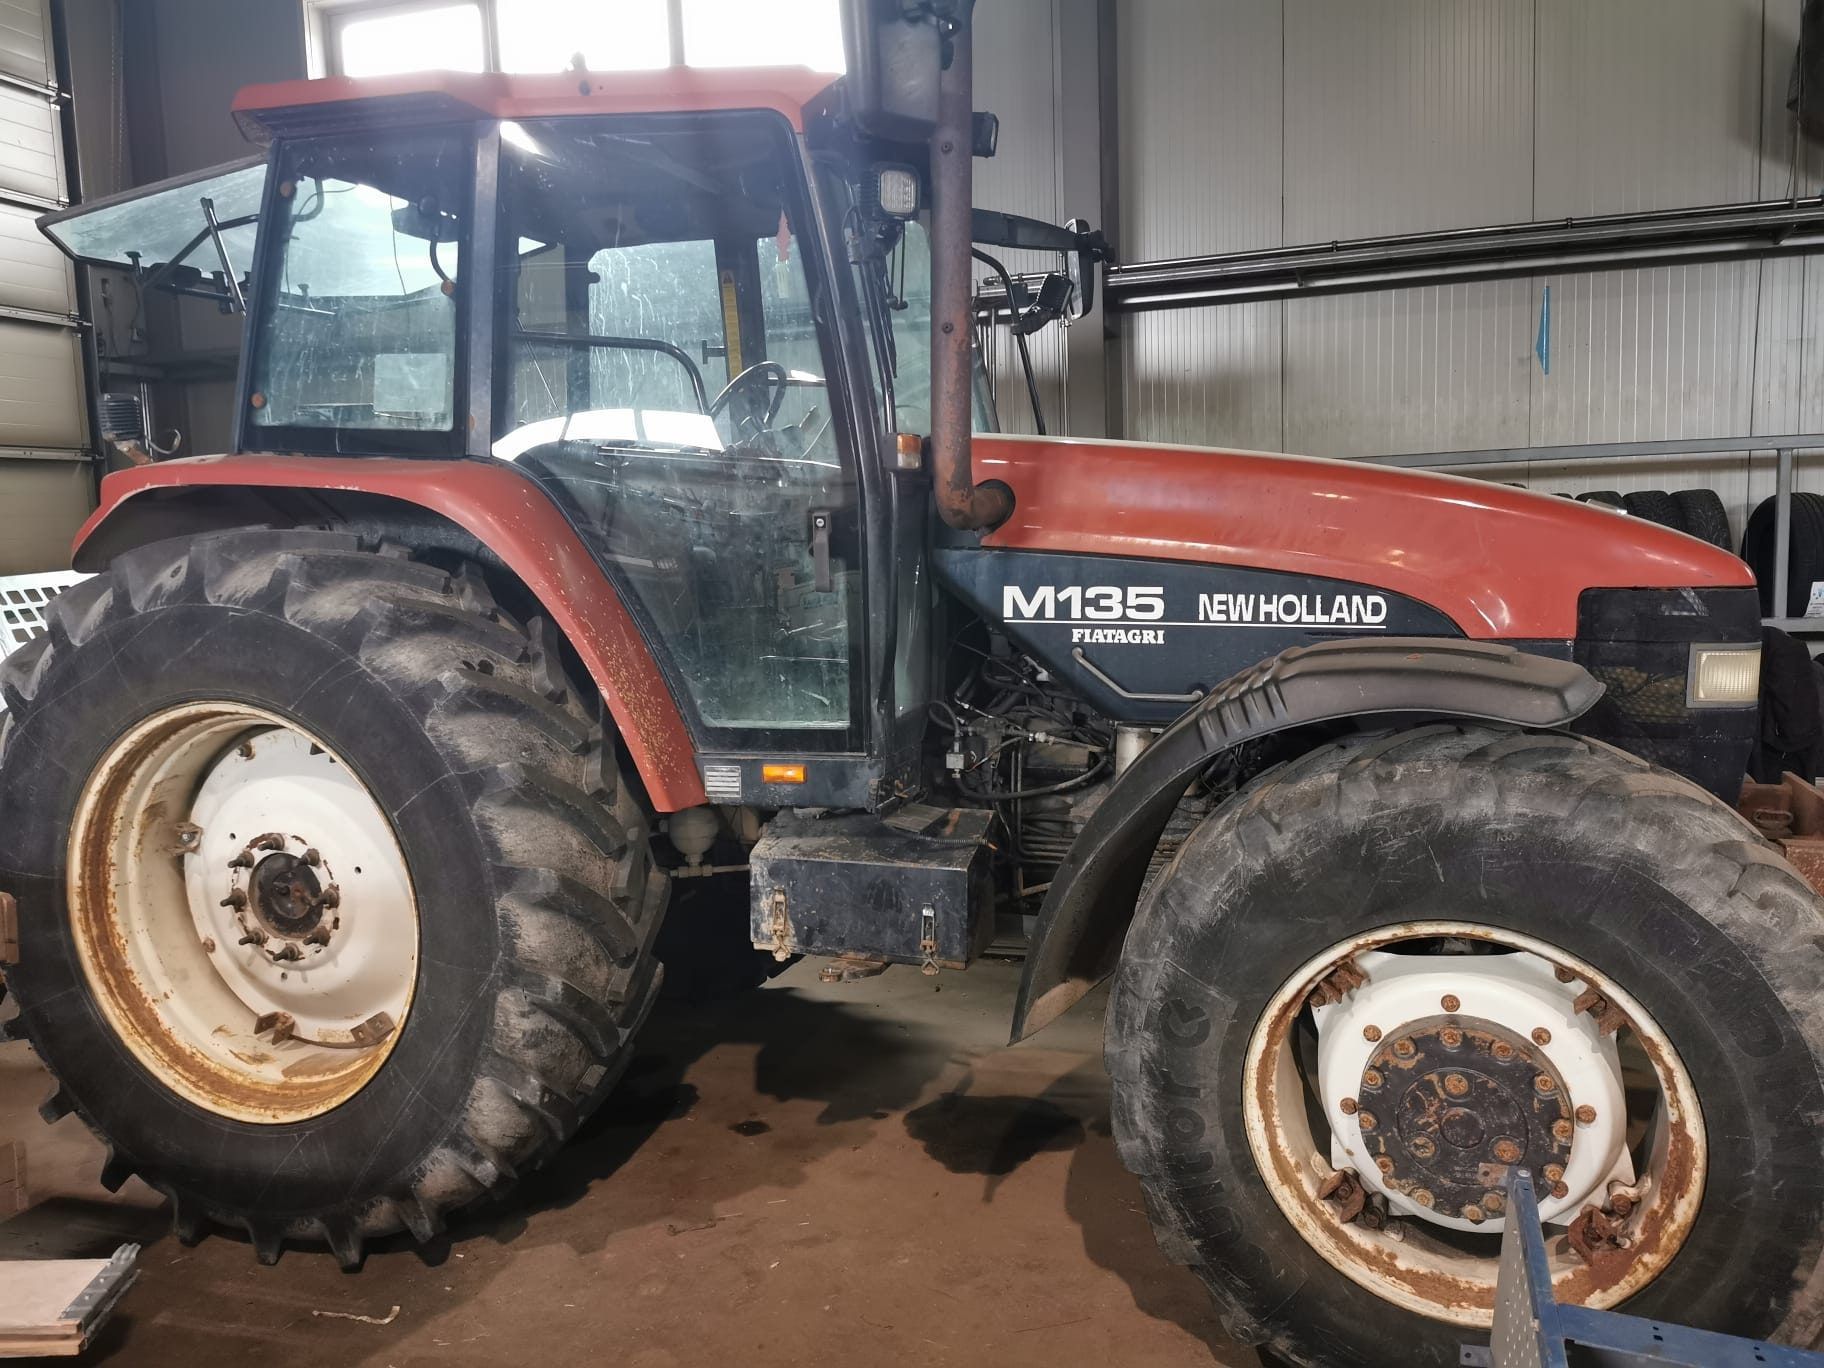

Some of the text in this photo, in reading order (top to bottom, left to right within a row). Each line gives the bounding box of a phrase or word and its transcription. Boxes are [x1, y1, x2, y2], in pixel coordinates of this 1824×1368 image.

[1003, 585, 1165, 620] M135
[1198, 593, 1388, 624] NEW HOLLAND
[1072, 628, 1165, 645] FIATAGRI
